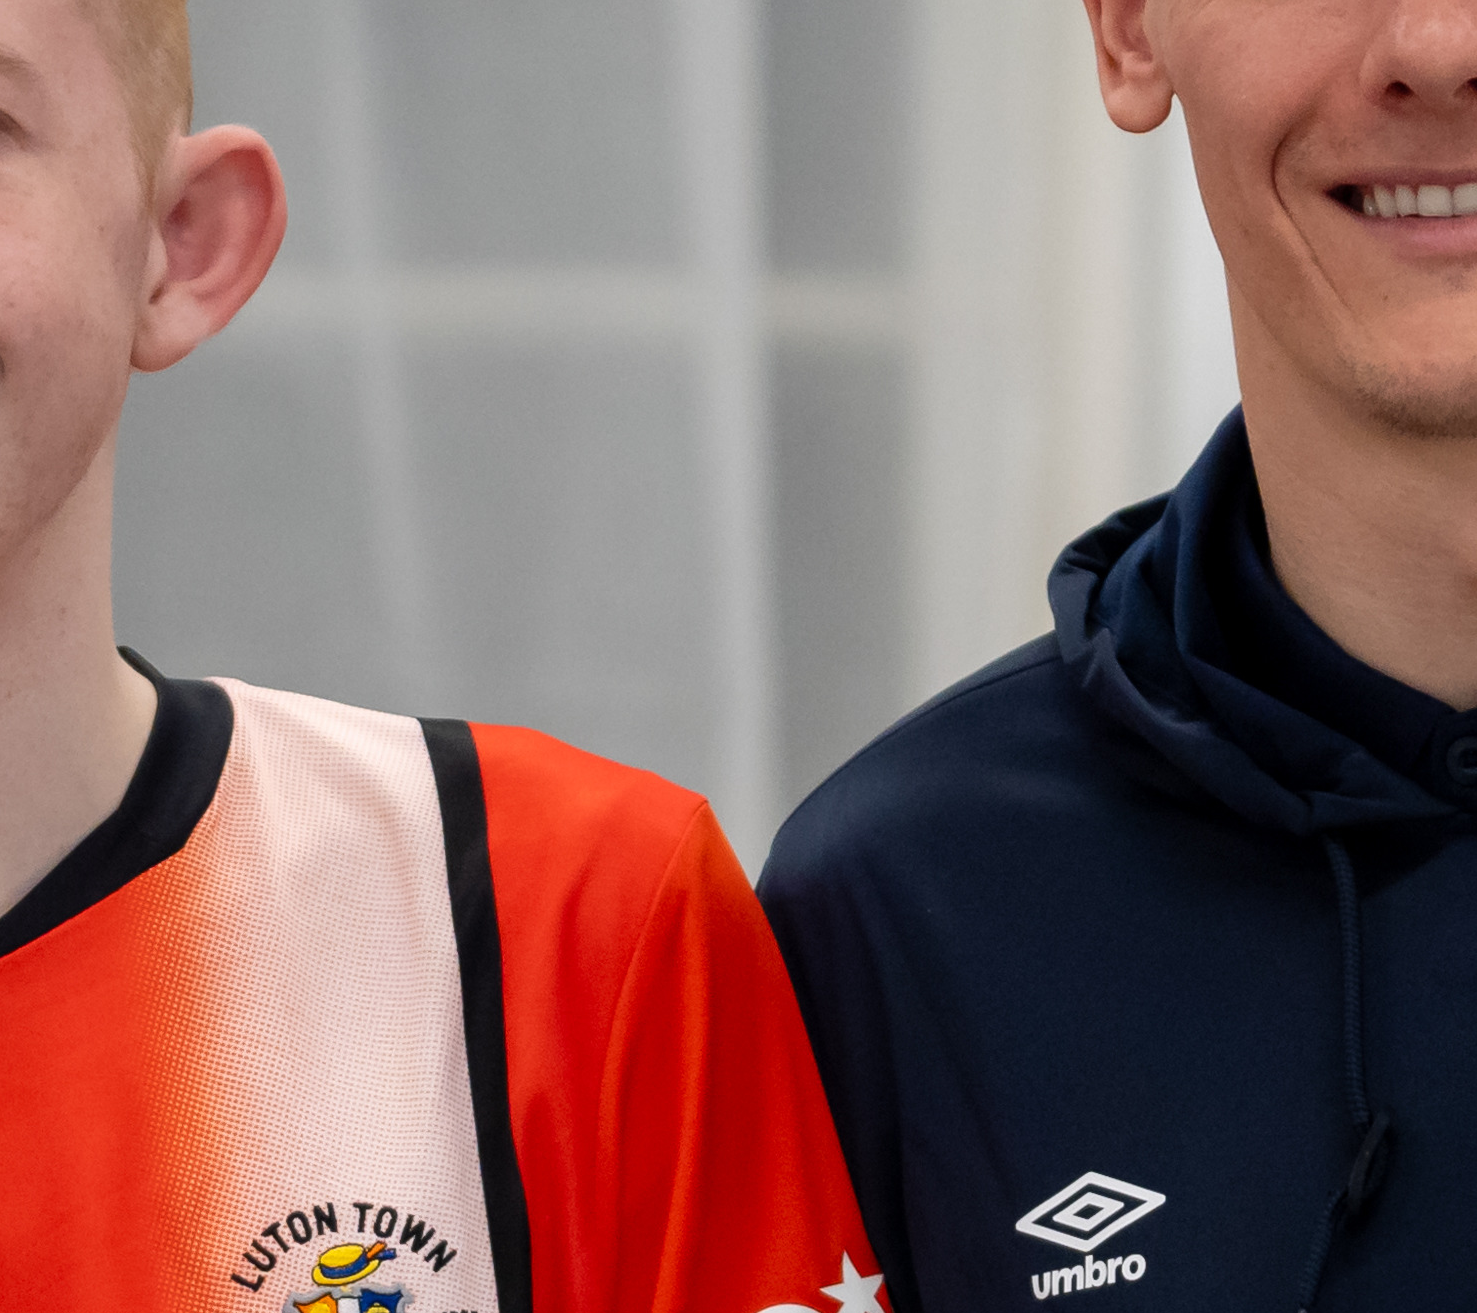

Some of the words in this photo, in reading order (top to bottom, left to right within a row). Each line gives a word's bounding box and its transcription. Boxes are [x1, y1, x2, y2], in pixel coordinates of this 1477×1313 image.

[231, 1202, 338, 1293] LUTON
[353, 1203, 457, 1273] TOWN
[1031, 1254, 1146, 1300] umbro
